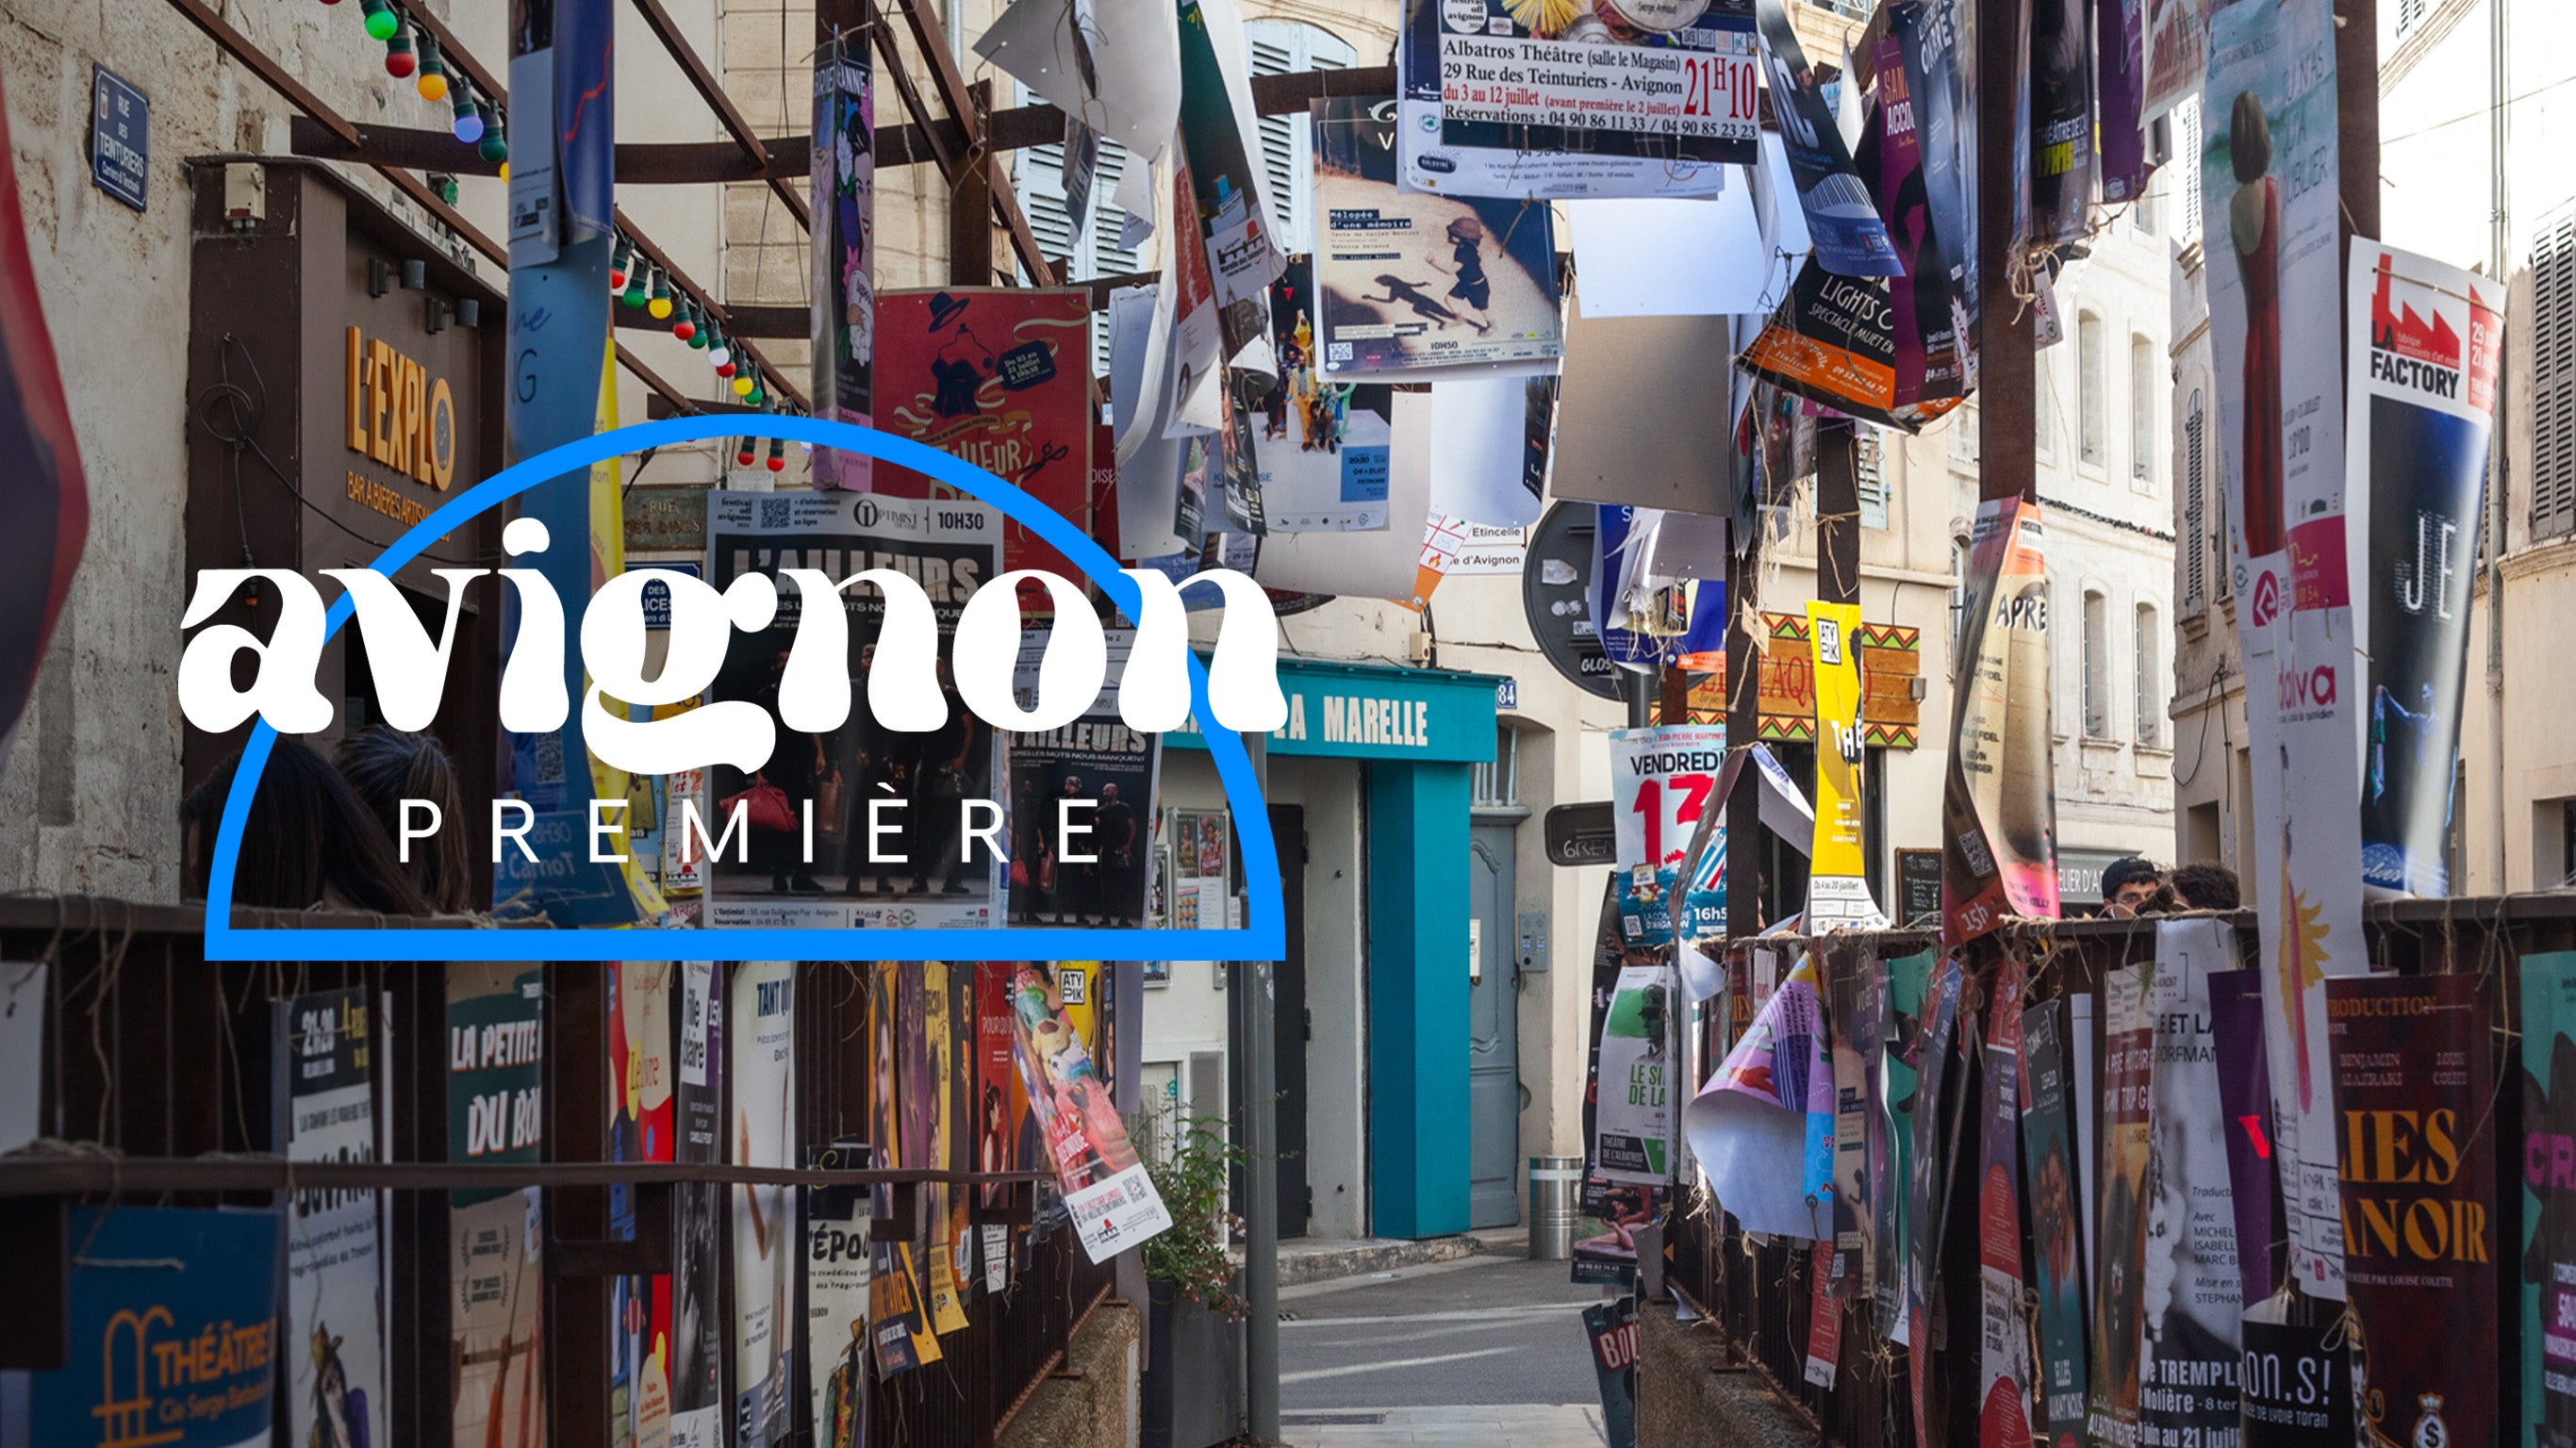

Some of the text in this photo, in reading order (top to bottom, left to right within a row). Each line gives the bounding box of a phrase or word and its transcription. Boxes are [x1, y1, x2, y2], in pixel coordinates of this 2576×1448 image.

[1447, 12, 1484, 22] avignon
[1444, 40, 1680, 74] Albatros Théâtre (salle le Magasin)
[1444, 62, 1683, 96] 29 Rue des Teinturiers Avignon
[1684, 57, 1756, 121] 21H10
[117, 94, 131, 119] RUE
[1444, 83, 1681, 117] du 3 au 12 juillet (avant première le 2 juillet)
[118, 123, 129, 140] DES
[1444, 104, 1756, 138] Réservations 04 90 86 11 33 04 90 85 23 23
[99, 132, 144, 178] TEINTURIERS
[1366, 221, 1412, 229] mémoire
[1819, 275, 1881, 321] LIGHTS
[1808, 302, 1858, 336] SPECTACLE
[1854, 327, 1885, 349] MUET
[2370, 319, 2397, 354] LA
[2370, 350, 2460, 400] FACTORY
[346, 325, 456, 493] L'EXPLO
[346, 470, 365, 502] BAR
[372, 481, 401, 519] BIÈRES
[721, 498, 752, 507] festival
[937, 511, 984, 531] 10H30
[1462, 554, 1520, 568] d'Avignon
[2404, 517, 2457, 620] JE
[647, 585, 667, 596] DES
[643, 597, 672, 612] ICE
[1497, 683, 1515, 705] 84
[1323, 695, 1428, 748] MARELLE
[1632, 773, 1715, 870] 13
[1063, 973, 1083, 988] ATY
[1061, 989, 1084, 1004] PIK
[2169, 1013, 2188, 1034] ET
[452, 1025, 476, 1072] LA
[1629, 1063, 1645, 1084] LE
[1628, 1084, 1646, 1106] DE
[468, 1090, 509, 1156] DU
[2339, 1108, 2458, 1186] IES
[2193, 1210, 2216, 1223] Avec
[2194, 1226, 2235, 1238] MICHEL
[2195, 1254, 2225, 1265] MARC
[2195, 1276, 2219, 1289] Mise
[2221, 1279, 2235, 1289] en
[151, 1318, 270, 1390] THÉÂTRE
[2143, 1388, 2237, 1413] Molière 8 ter
[2161, 1425, 2179, 1445] au
[2182, 1425, 2200, 1445] 21
